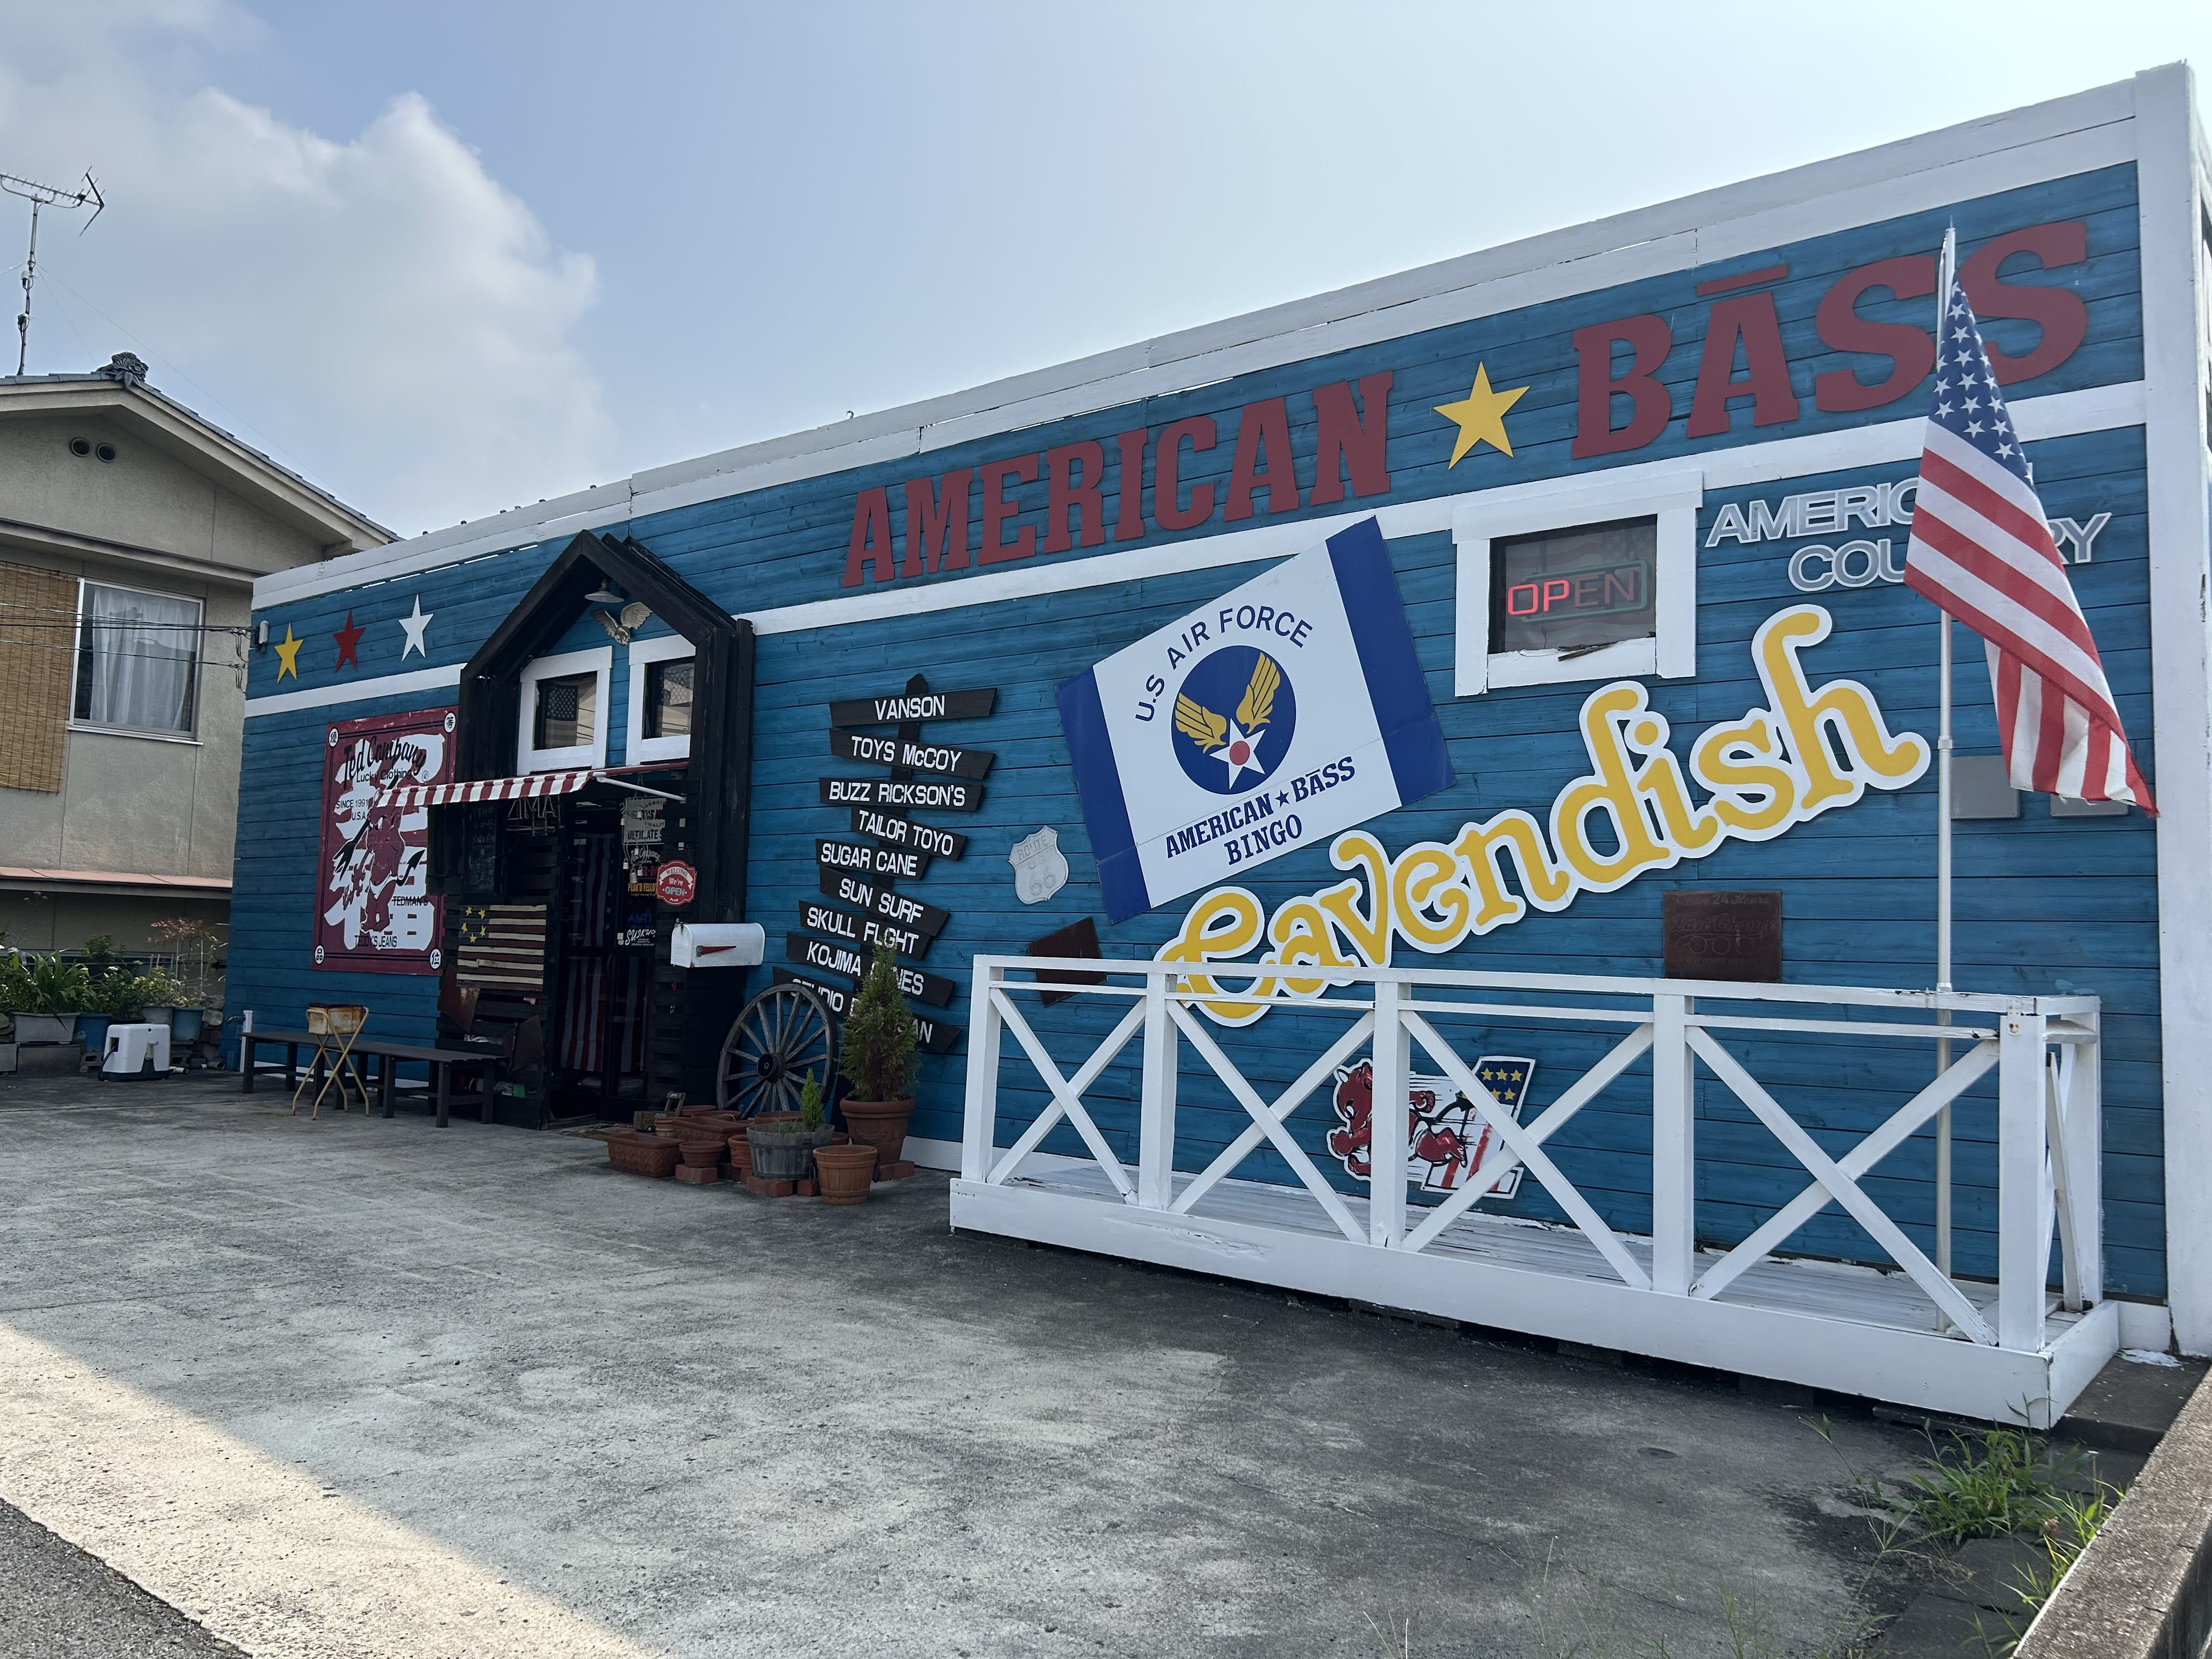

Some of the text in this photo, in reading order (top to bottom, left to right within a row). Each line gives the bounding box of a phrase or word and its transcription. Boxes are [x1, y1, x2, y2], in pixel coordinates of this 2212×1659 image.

[843, 370, 1394, 589] AMERICAN
[1705, 477, 1919, 548] AMERIC
[1788, 512, 2112, 592] COUY
[1507, 570, 1635, 616] OPEN
[1166, 621, 1210, 670] AIR
[1219, 605, 1313, 648] FORCE
[875, 695, 945, 720] VANSON
[343, 735, 427, 790] Ted Company
[851, 736, 962, 771] TOYS McCOY
[357, 768, 413, 782] Lucky Clothing
[336, 799, 369, 809] SINCE 1991
[829, 782, 965, 806] BUZZ RICKSON'S
[1155, 604, 1931, 1027] Cavendish
[1165, 792, 1272, 859] AMERICAN
[859, 810, 953, 855] TAILOR TOYO
[1017, 835, 1048, 860] ROUTE
[1223, 814, 1302, 866] BINGO
[666, 868, 688, 878] WELCOME
[821, 843, 918, 876] SUGAR CANE
[665, 886, 685, 895] OPEN
[1029, 865, 1056, 895] 66
[393, 896, 428, 906] TEDMAN'S
[839, 878, 923, 923] SUN SURF
[1712, 894, 1729, 905] 24
[807, 907, 855, 938] SKULL
[316, 949, 323, 960] 品
[354, 935, 397, 948] TEDDY'S JEANS
[806, 941, 924, 996] KOJIMA NES
